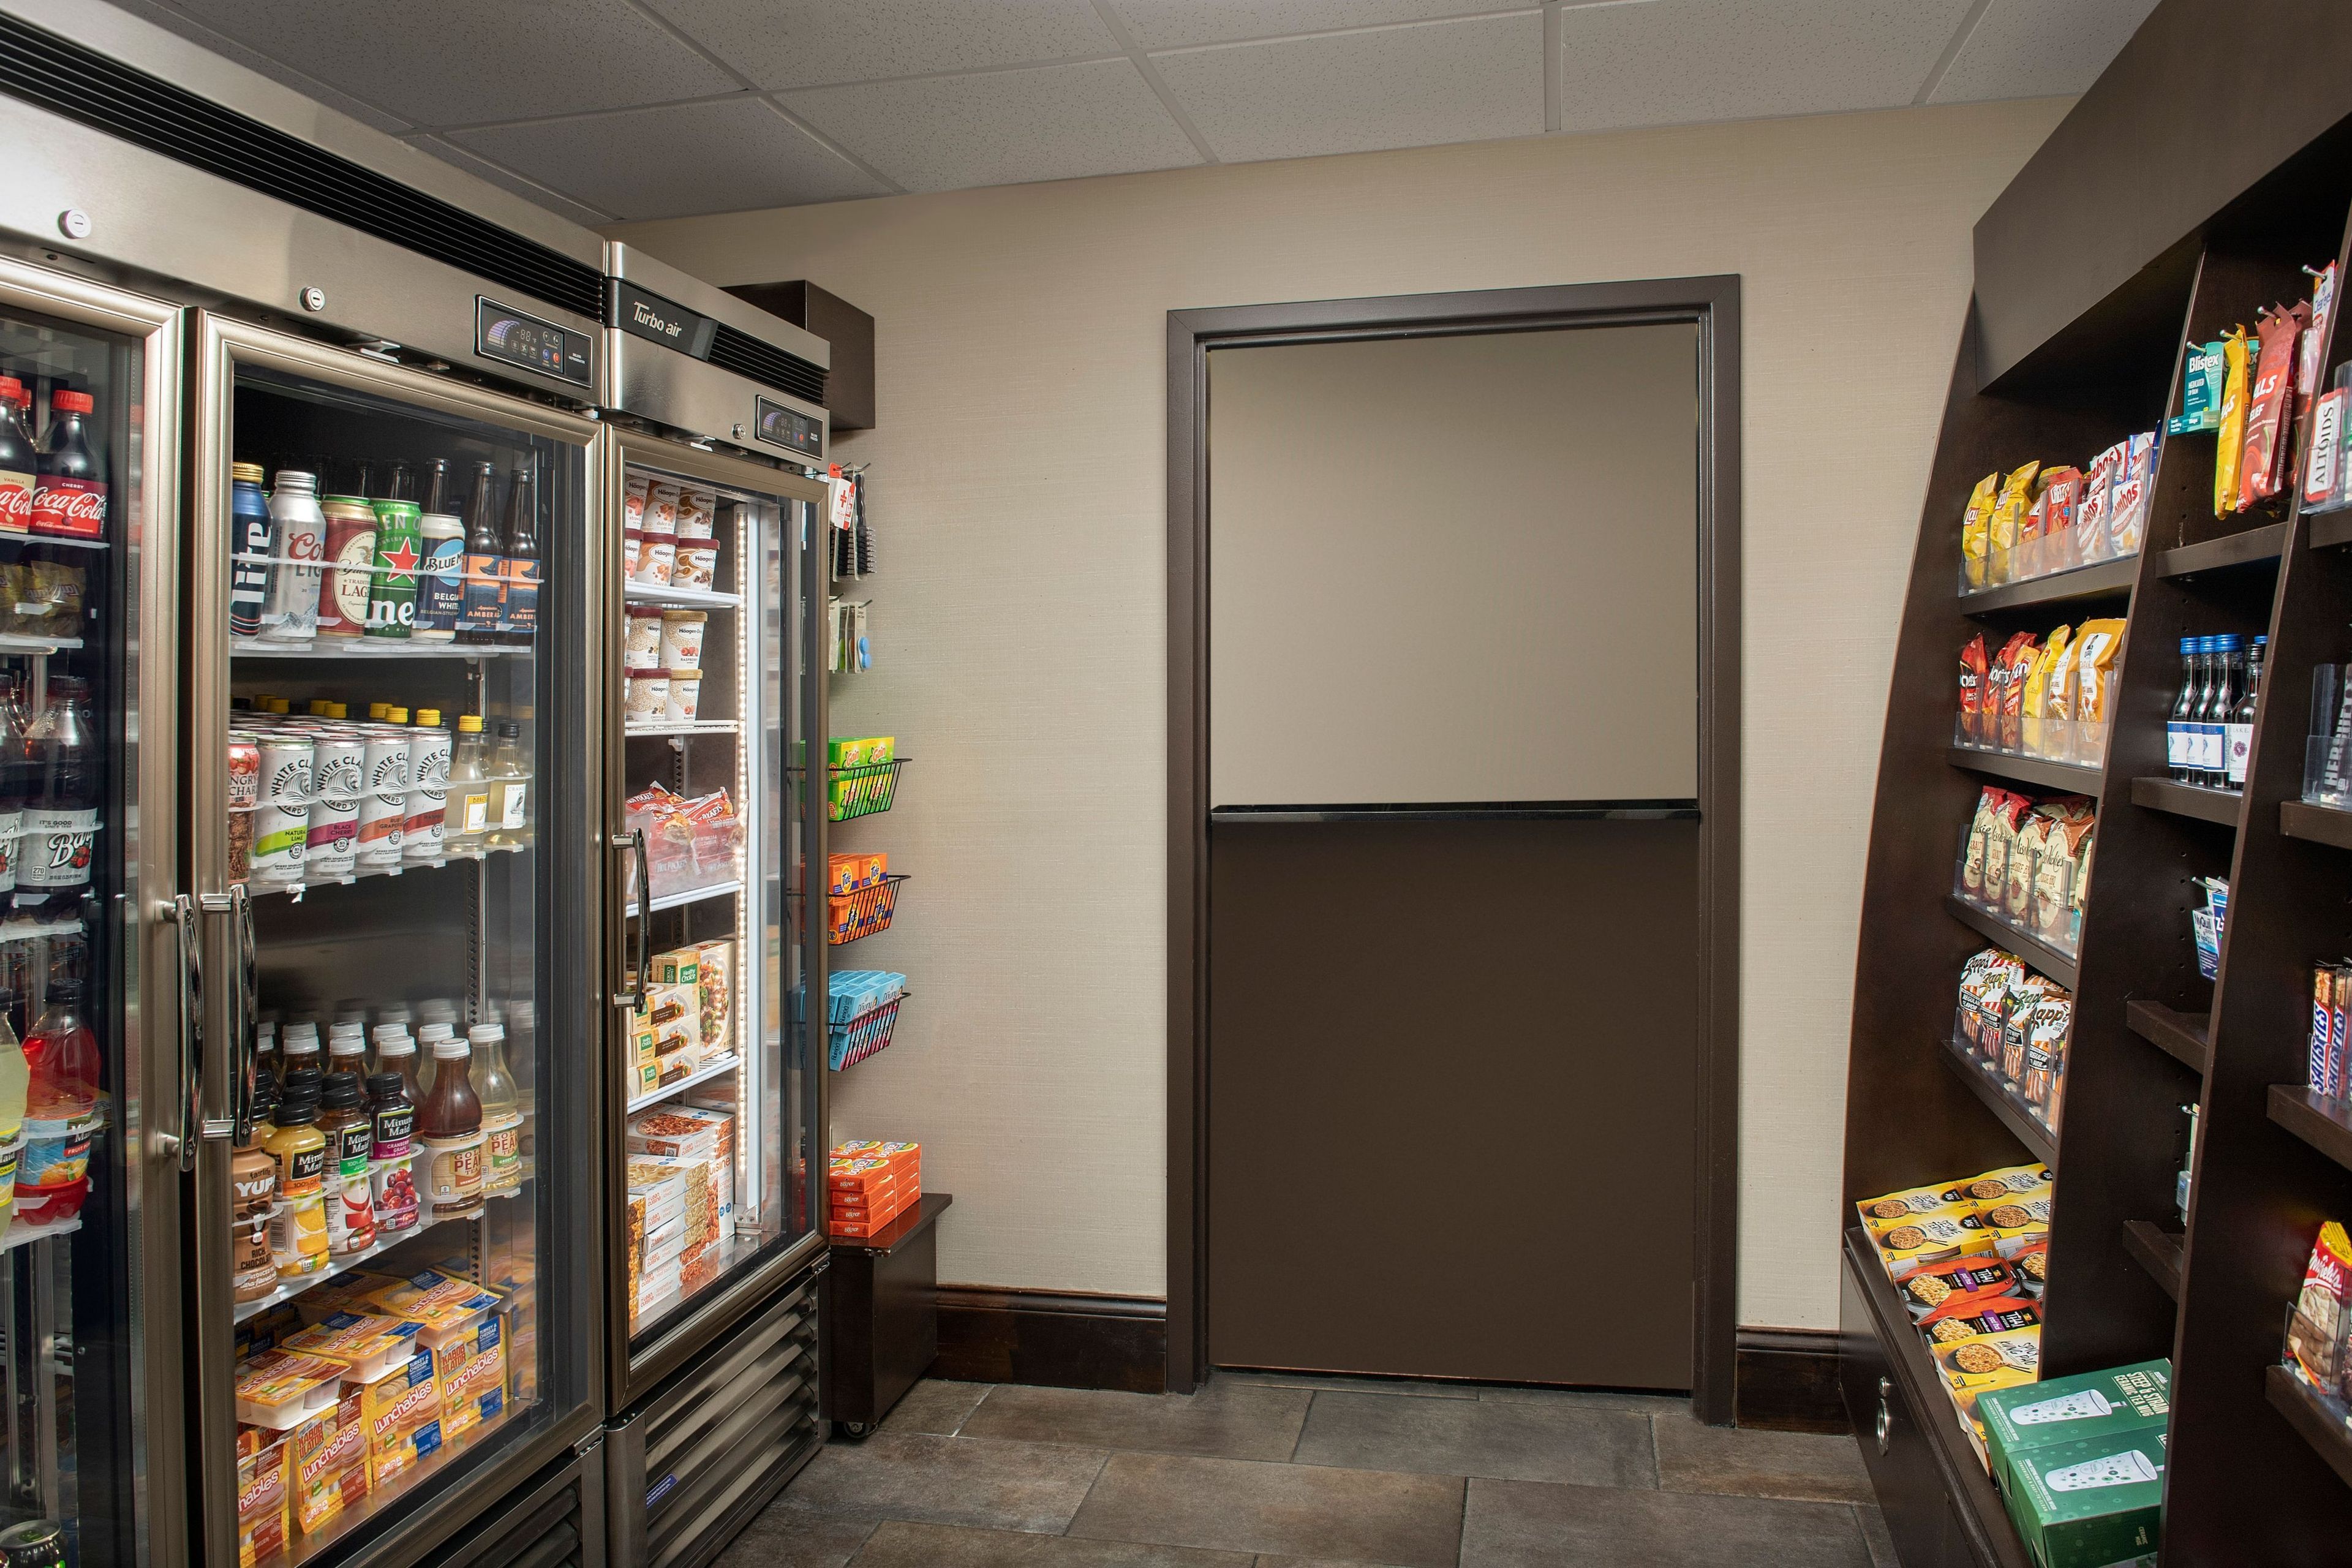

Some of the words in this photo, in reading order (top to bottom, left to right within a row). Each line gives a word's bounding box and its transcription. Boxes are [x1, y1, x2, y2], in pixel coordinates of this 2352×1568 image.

[633, 301, 665, 331] Turbo
[665, 322, 682, 337] air
[2188, 353, 2220, 374] Blistex
[2314, 406, 2334, 487] ALTOIDS
[31, 486, 107, 521] Coca-Cola
[424, 556, 458, 571] BLUE
[846, 749, 860, 767] Gain
[872, 746, 886, 763] Gain
[317, 759, 341, 791] WHITE
[372, 755, 395, 787] WHITE
[417, 752, 439, 782] WHITE
[271, 762, 297, 796] WHITE
[842, 870, 851, 888] Tide
[870, 864, 880, 880] Tide
[681, 973, 696, 982] Choice
[682, 968, 696, 976] Healthy
[383, 1116, 413, 1129] Minute
[388, 1124, 411, 1137] Maid
[67, 1146, 83, 1155] FRUIT
[251, 1246, 266, 1259] RICH
[1977, 1268, 1996, 1284] THAI
[401, 1281, 456, 1314] Lunchables
[2006, 1311, 2026, 1328] THAI
[409, 1357, 425, 1368] TURKEY
[409, 1359, 429, 1373] CHEDDAR
[445, 1348, 499, 1398] Lunchables
[2113, 1374, 2139, 1396] CERAMIC
[2126, 1371, 2152, 1388] STEEP
[2143, 1392, 2170, 1415] STRAIN
[373, 1382, 433, 1436] Lunchables
[2129, 1394, 2146, 1406] TEA
[2136, 1404, 2155, 1417] MUG
[301, 1423, 360, 1485] Lunchables
[238, 1470, 280, 1513] hables
